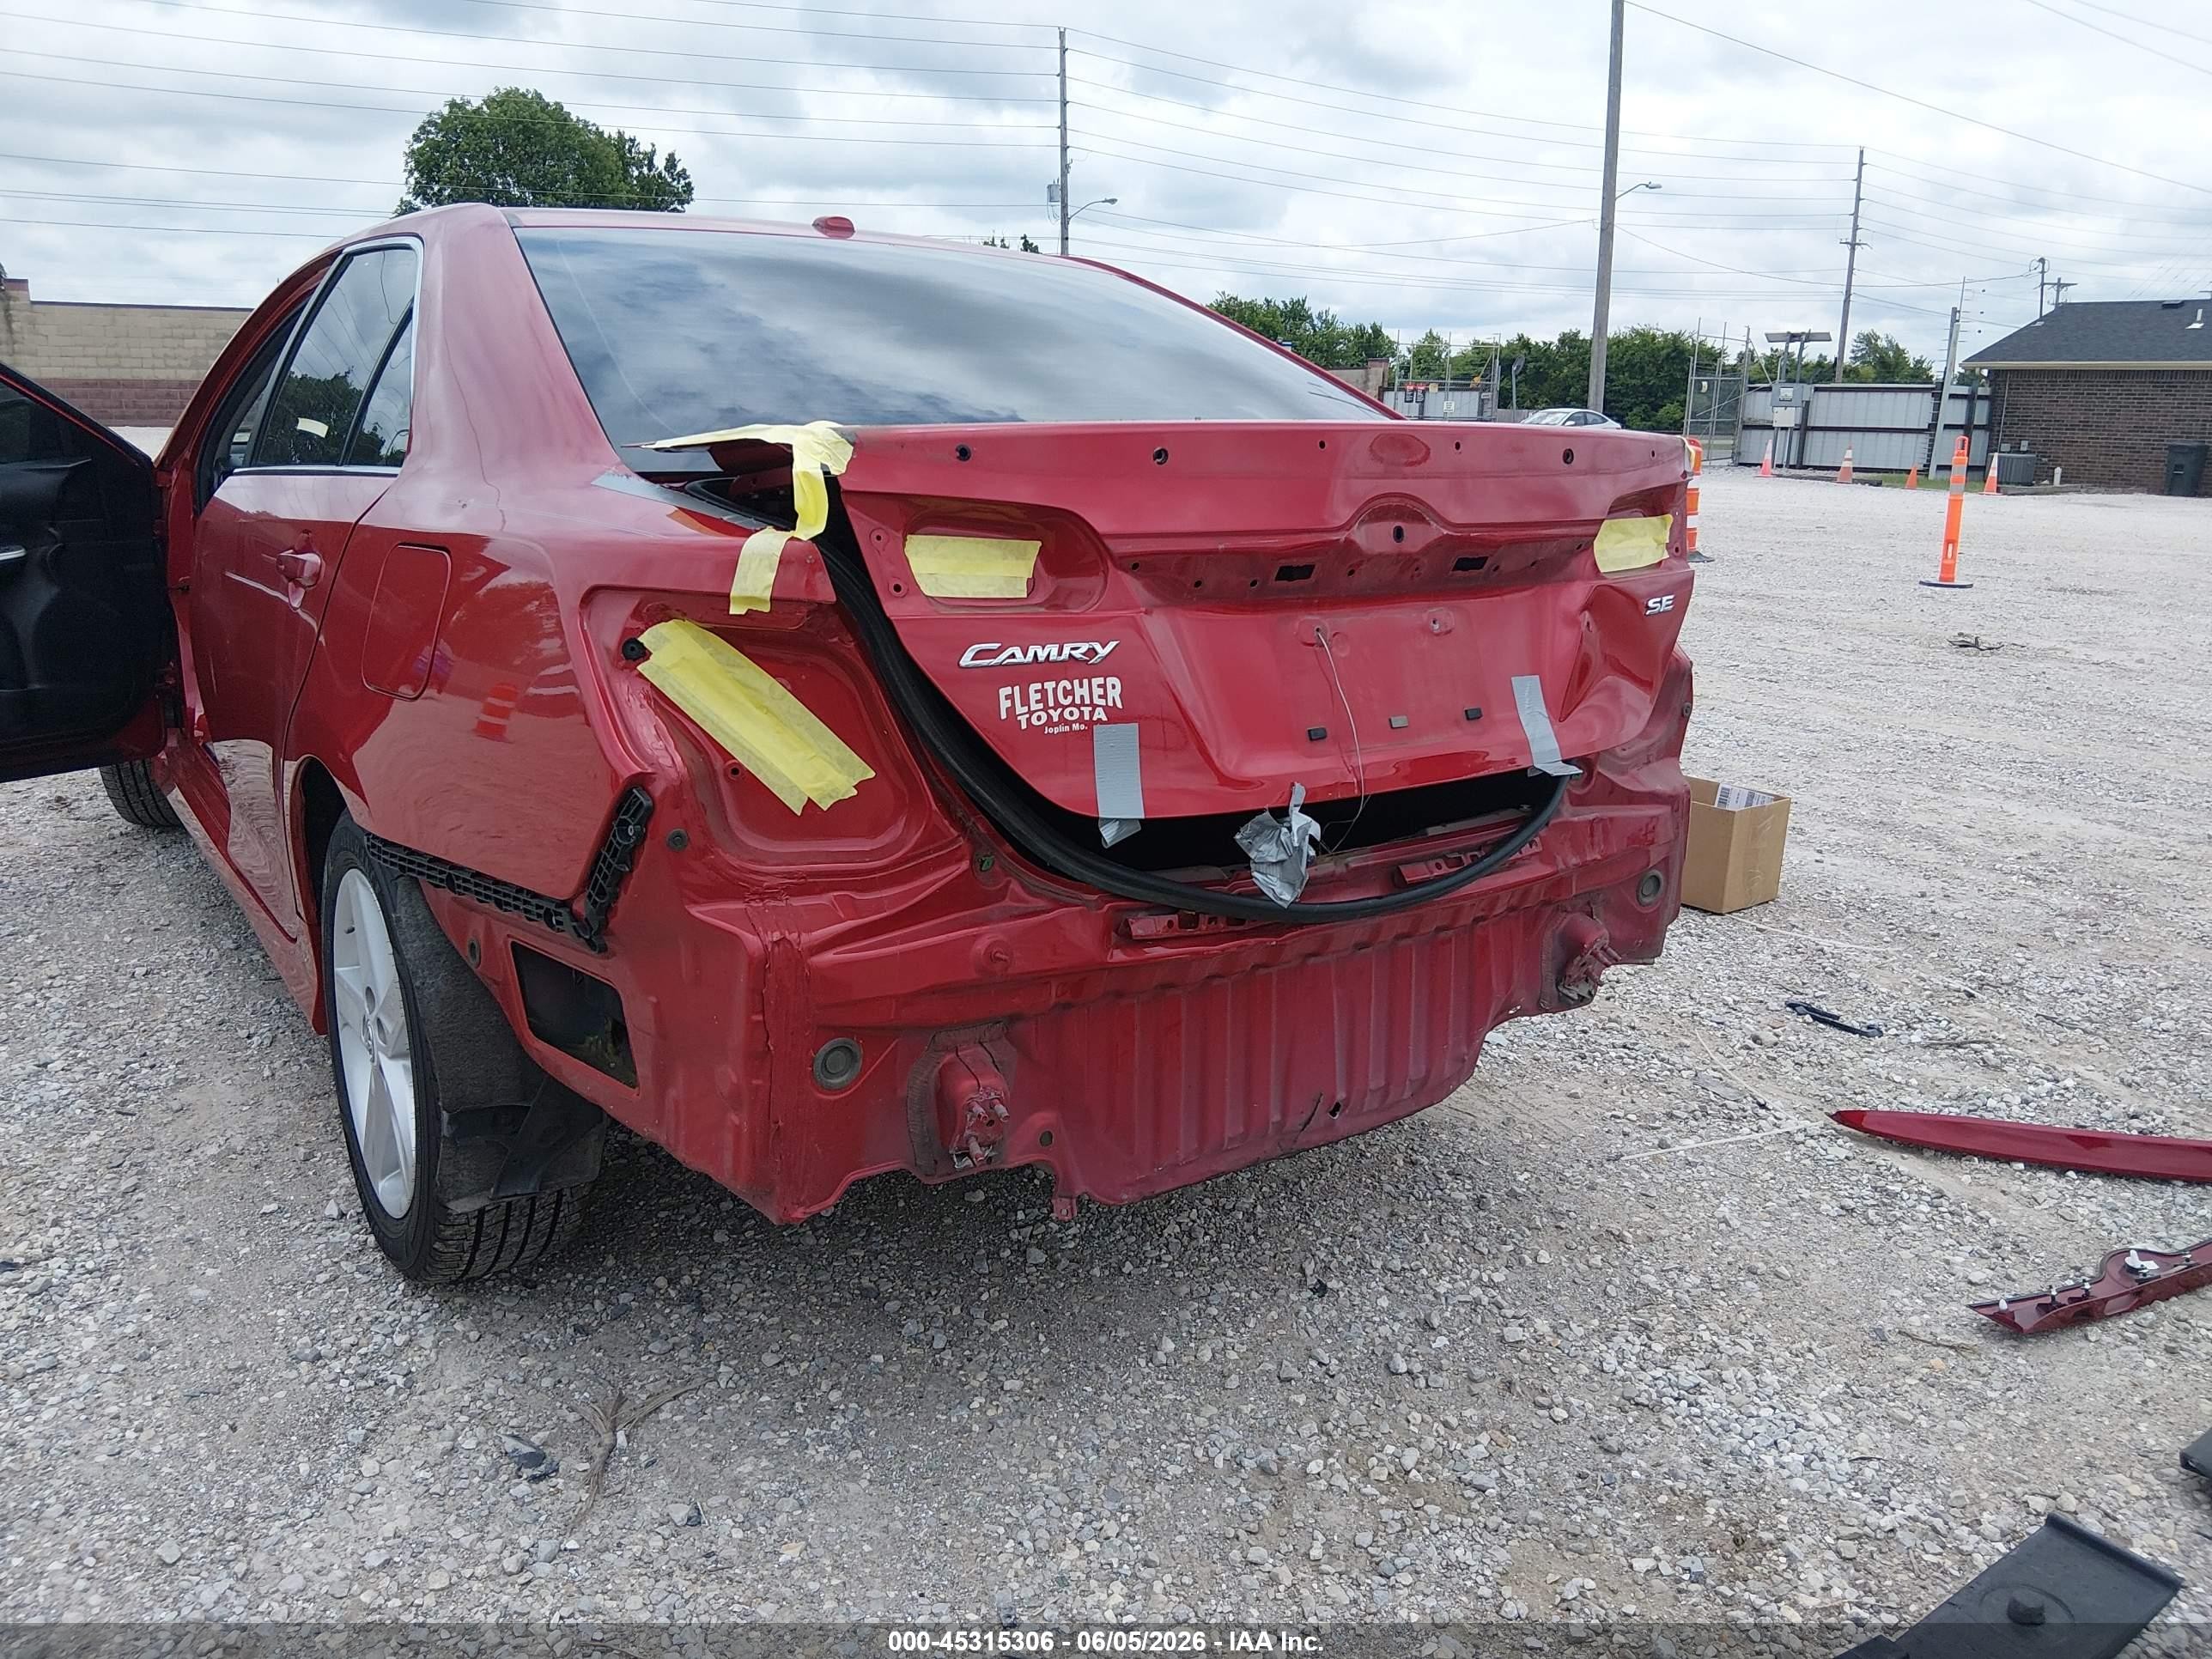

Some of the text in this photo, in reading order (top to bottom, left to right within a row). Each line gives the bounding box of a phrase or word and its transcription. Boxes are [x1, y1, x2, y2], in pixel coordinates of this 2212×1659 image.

[1645, 594, 1675, 616] SE
[958, 641, 1120, 667] CAMRY
[999, 677, 1123, 720] FLETCHER
[1017, 707, 1108, 730] TOYOTA
[1044, 722, 1088, 734] Joplin Mo.
